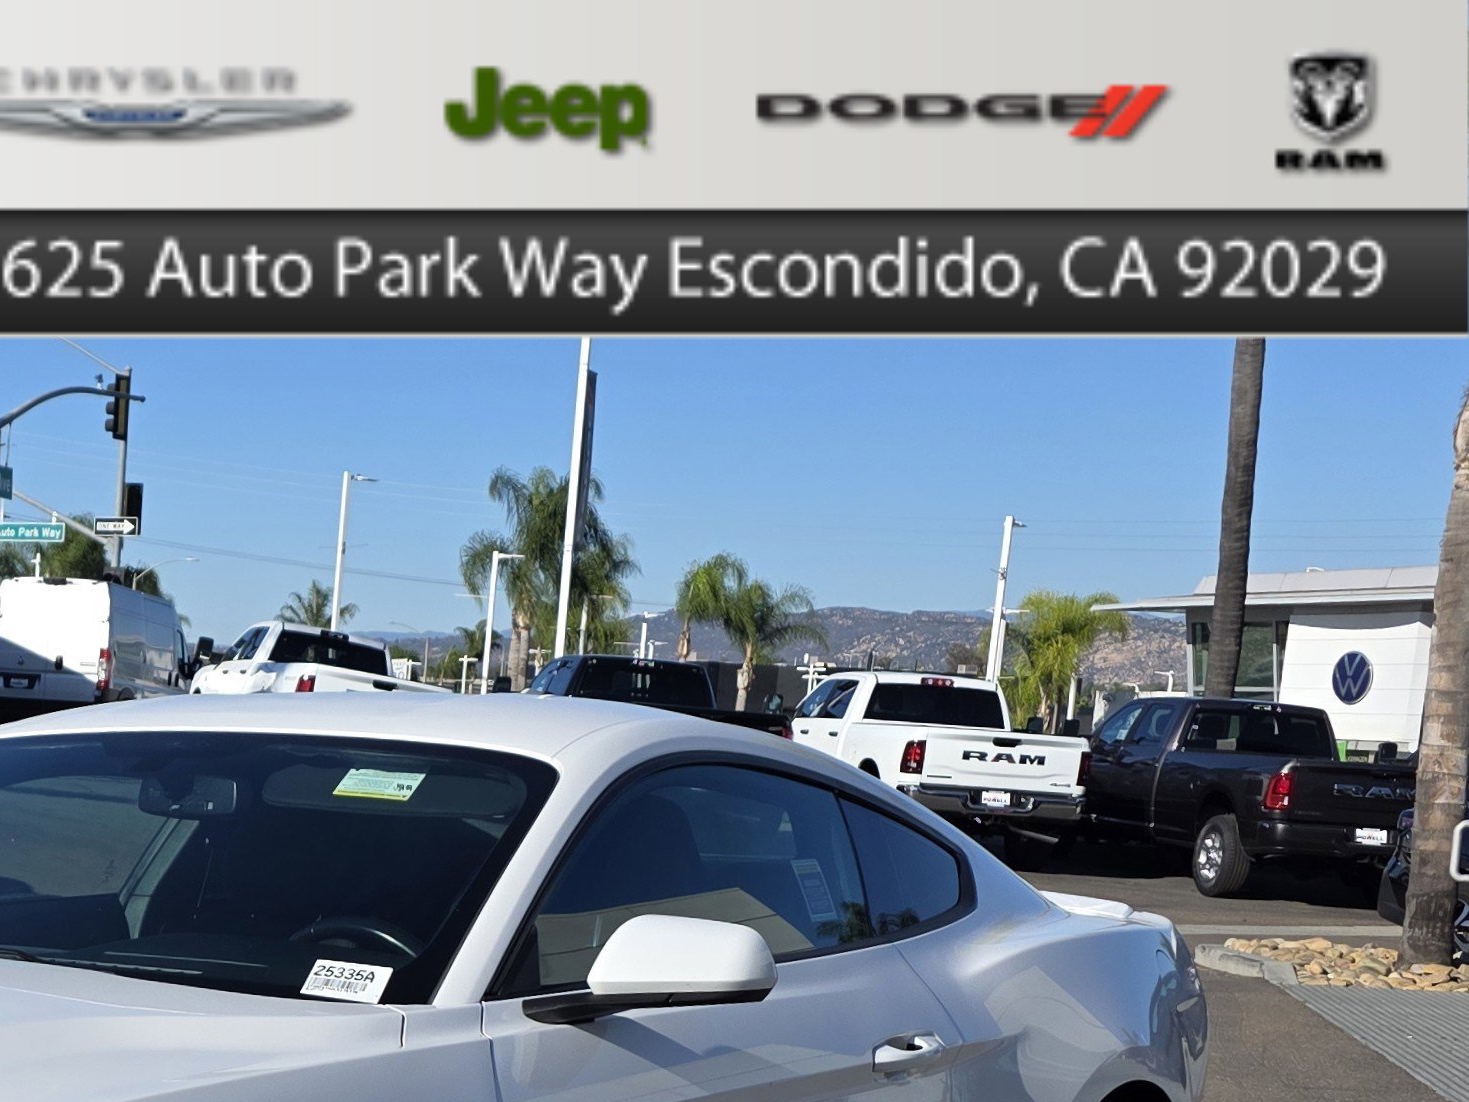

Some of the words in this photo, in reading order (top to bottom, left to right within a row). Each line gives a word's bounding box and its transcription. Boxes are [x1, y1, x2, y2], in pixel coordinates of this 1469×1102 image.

[18, 527, 39, 538] Park
[41, 527, 62, 540] Way
[961, 749, 1046, 766] RAM
[313, 964, 375, 983] 25335A
